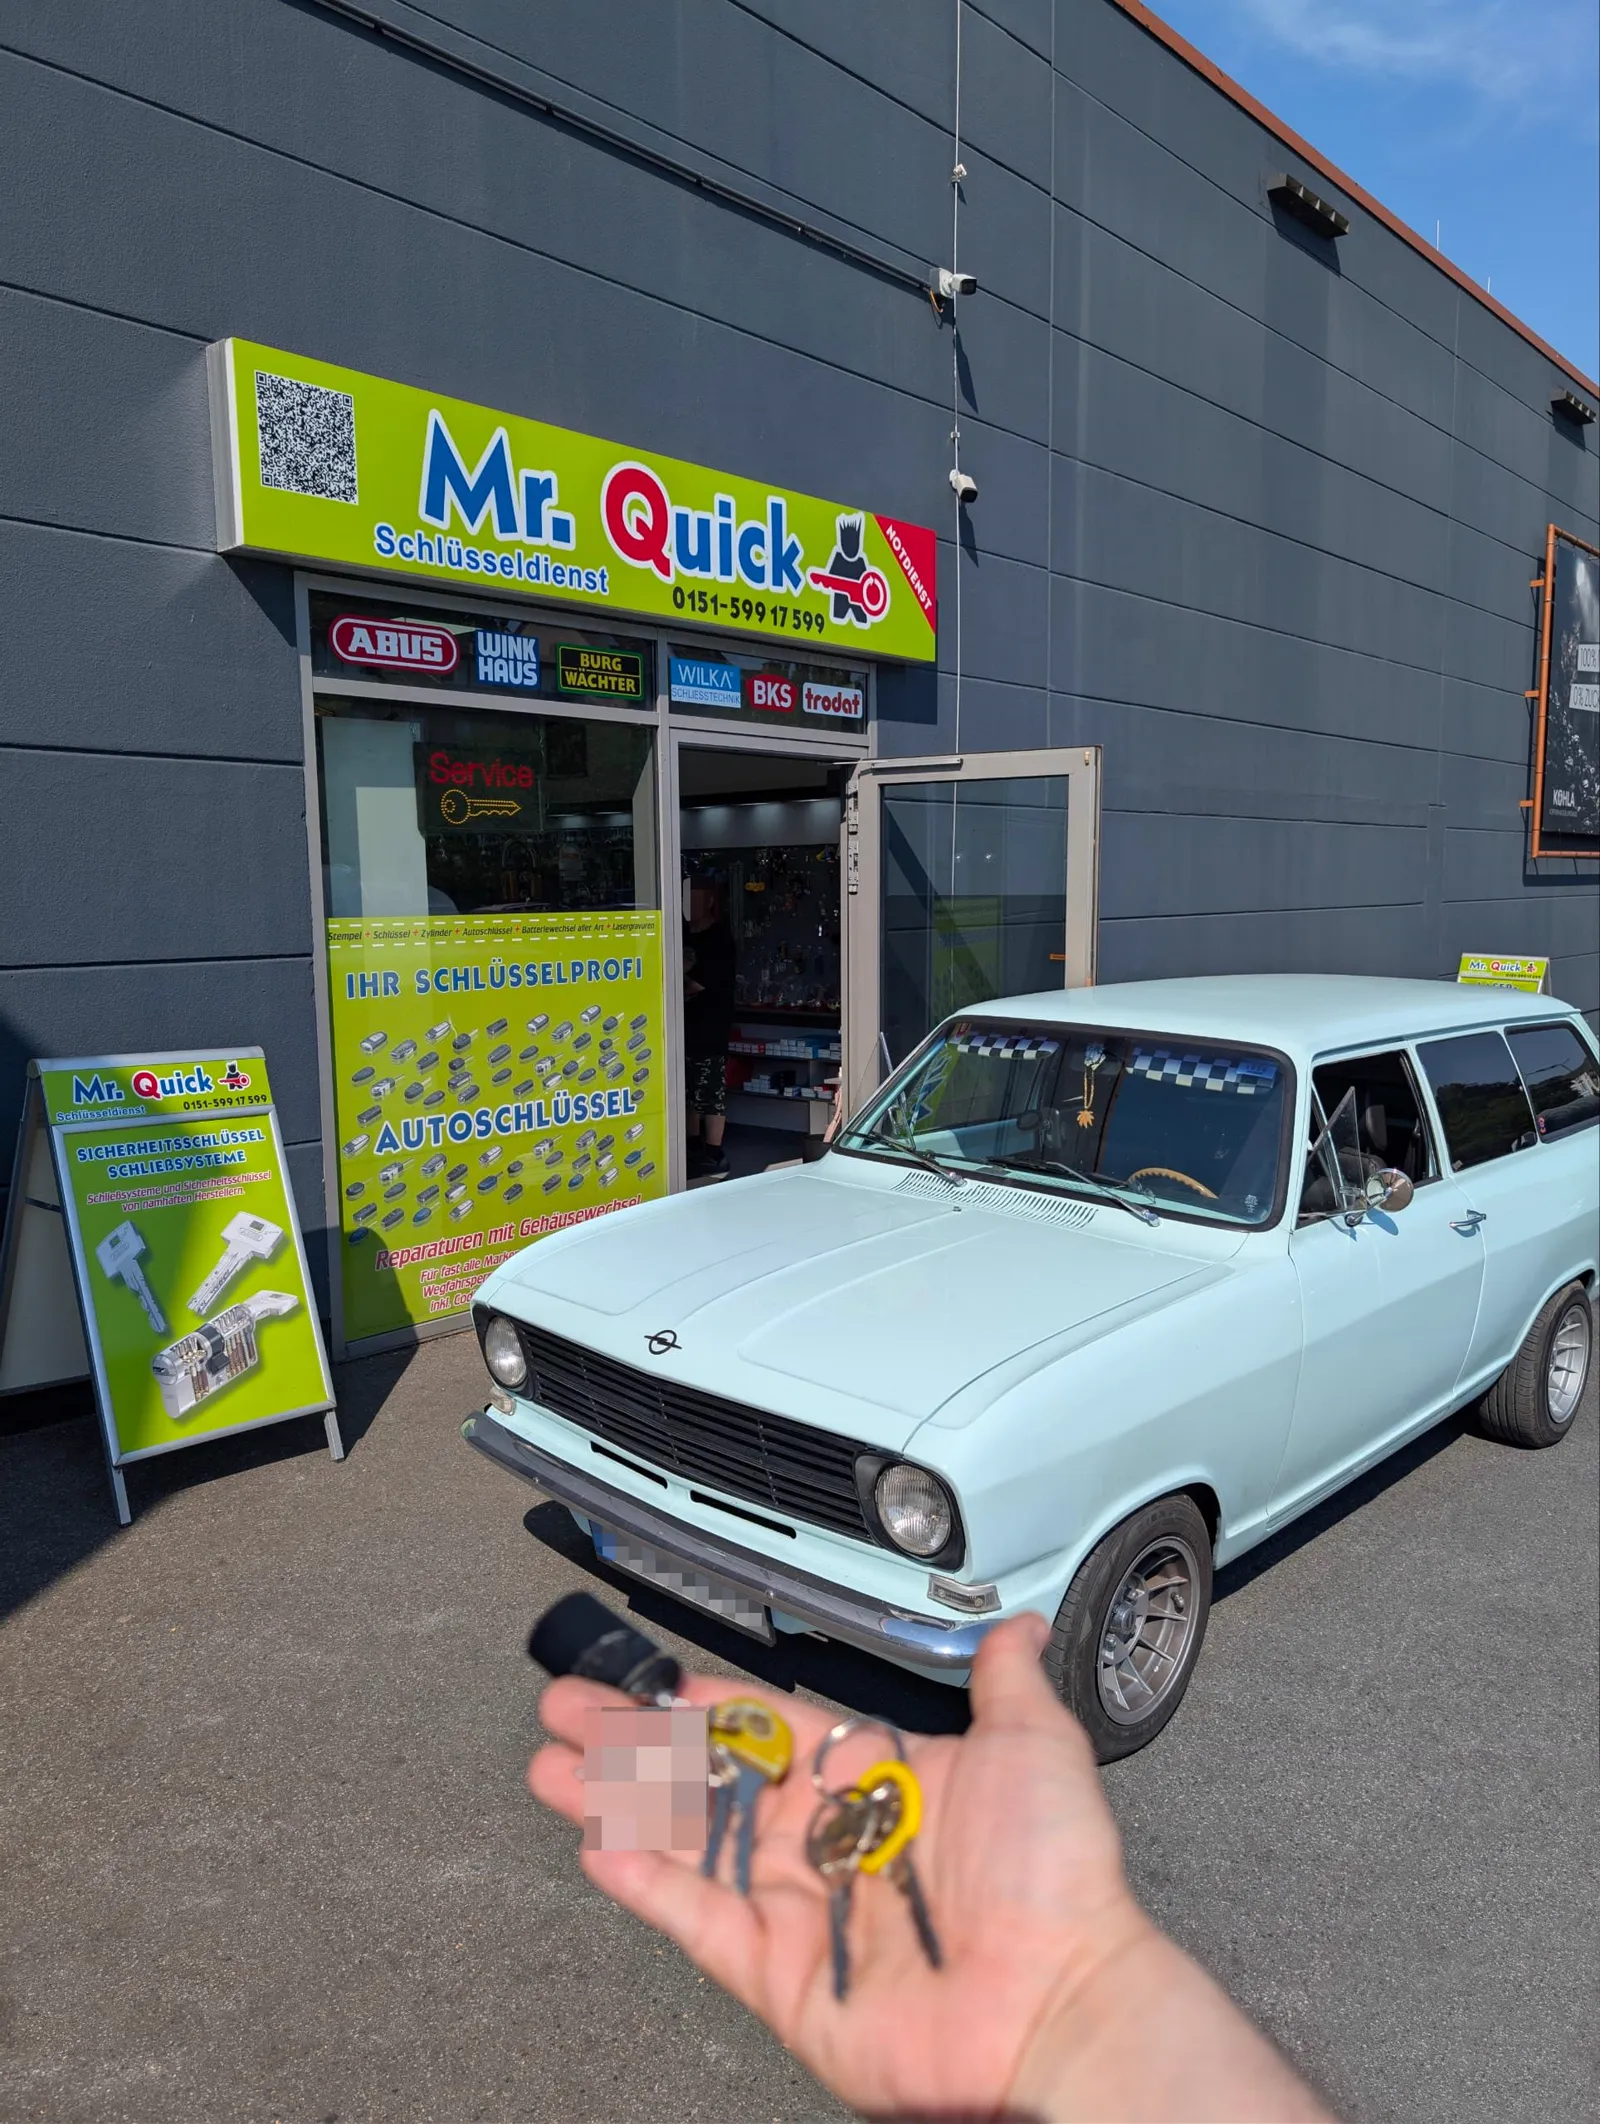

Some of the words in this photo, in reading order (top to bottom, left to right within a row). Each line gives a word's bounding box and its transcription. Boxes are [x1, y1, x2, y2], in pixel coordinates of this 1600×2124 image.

[422, 413, 573, 548] Mr.
[603, 464, 803, 594] Quick
[375, 523, 609, 594] Schlüsseldienst
[885, 524, 933, 610] NOTDIENST
[672, 586, 766, 623] 0151-599
[770, 605, 788, 628] 17
[792, 609, 825, 634] 599
[348, 627, 443, 663] ABUS
[478, 632, 537, 662] WINK
[1579, 647, 1598, 669] 100%
[478, 657, 538, 686] HAUS
[580, 653, 622, 672] BURG
[565, 668, 636, 693] WÄCHTER
[753, 680, 792, 708] BKS
[672, 687, 741, 705] SCHLIESSTECHNIK
[805, 687, 860, 715] trodat
[429, 752, 534, 789] Service
[328, 931, 363, 942] Stempel
[373, 929, 411, 940] Schlüssel
[421, 928, 453, 939] Zylinder
[522, 923, 576, 934] Batteriewechsel
[594, 923, 605, 932] Art
[613, 922, 655, 932] Lasergravuren
[346, 971, 401, 999] IHR
[415, 958, 643, 994] SCHLÜSSELPROFI
[1468, 959, 1487, 971] Mr.
[1490, 959, 1522, 972] Quick
[73, 1074, 124, 1104] Mr.
[132, 1066, 213, 1099] Quick
[57, 1105, 146, 1123] Schlüsseldienst
[183, 1097, 233, 1111] 0151-599
[235, 1096, 246, 1106] 17
[248, 1093, 267, 1105] 599
[374, 1088, 637, 1155] AUTOSCHLÜSSEL
[77, 1129, 265, 1162] SICHERHEITSSCHLÜSSEL
[87, 1187, 161, 1204] Schließsysteme
[163, 1183, 181, 1194] und
[183, 1170, 272, 1191] Sicherheitsschlüssel
[122, 1201, 140, 1213] von
[142, 1193, 197, 1210] namhaften
[375, 1231, 484, 1270] Reparaturen
[488, 1222, 514, 1245] mit
[421, 1269, 439, 1283] Für
[441, 1262, 460, 1278] fast
[463, 1258, 481, 1272] alle
[484, 1249, 519, 1267] Marke
[430, 1296, 450, 1313] inkl.
[454, 1290, 476, 1306] Cod
